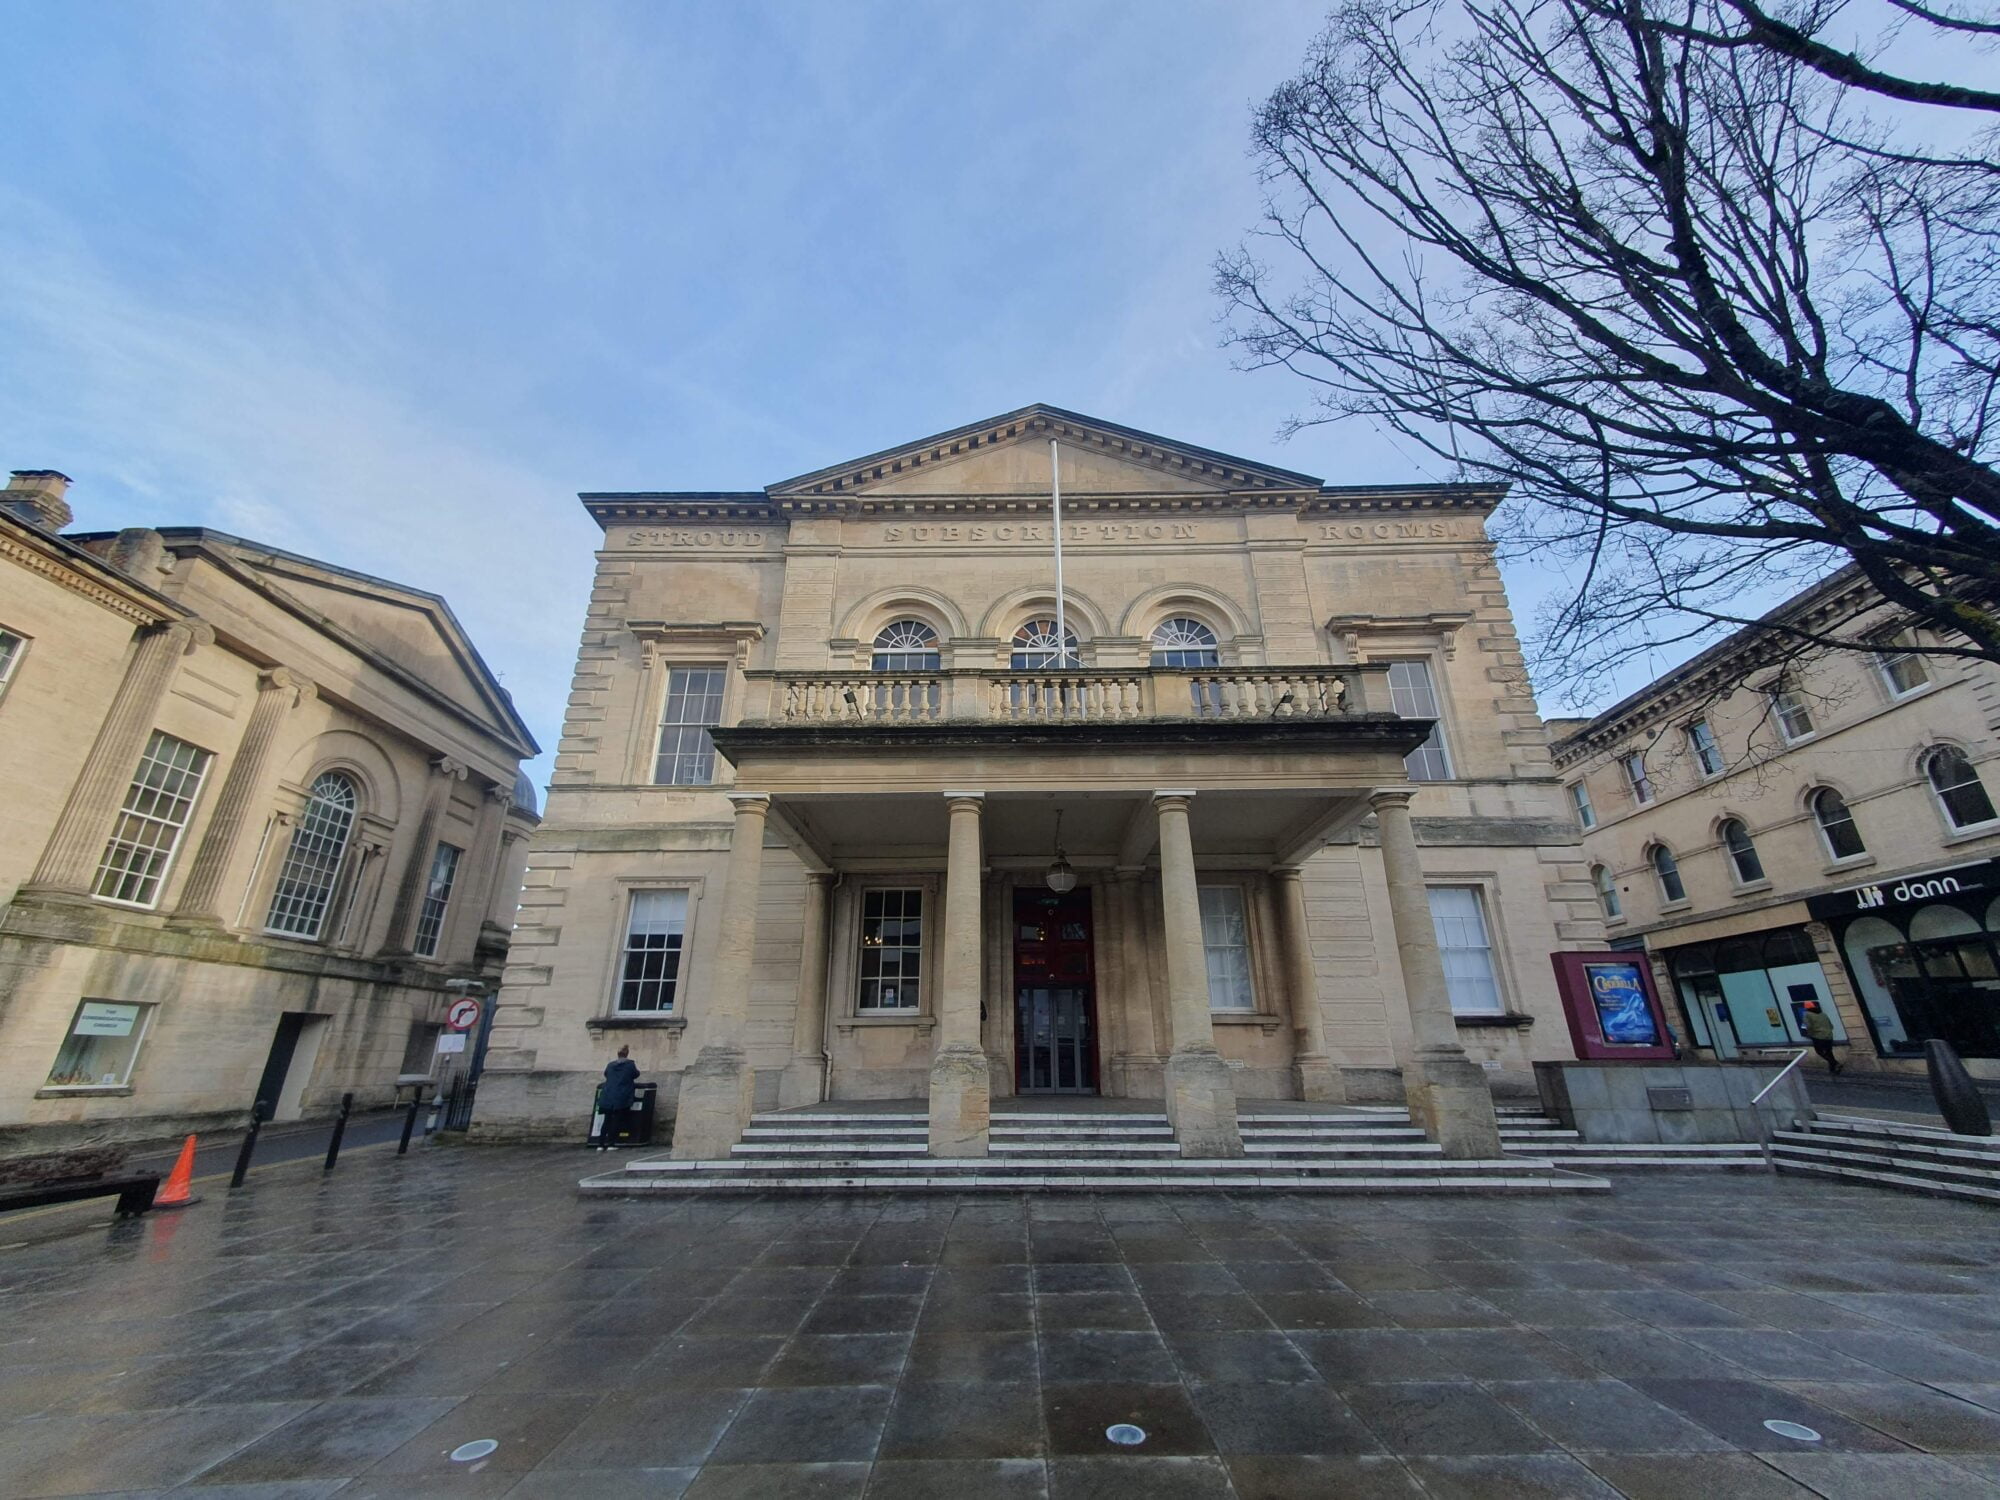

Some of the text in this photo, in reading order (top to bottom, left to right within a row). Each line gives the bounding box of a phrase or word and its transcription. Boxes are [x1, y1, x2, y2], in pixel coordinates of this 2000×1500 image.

[627, 531, 766, 547] STROUD
[884, 523, 1199, 542] SUBSCRIPTION
[1893, 876, 1960, 902] dann
